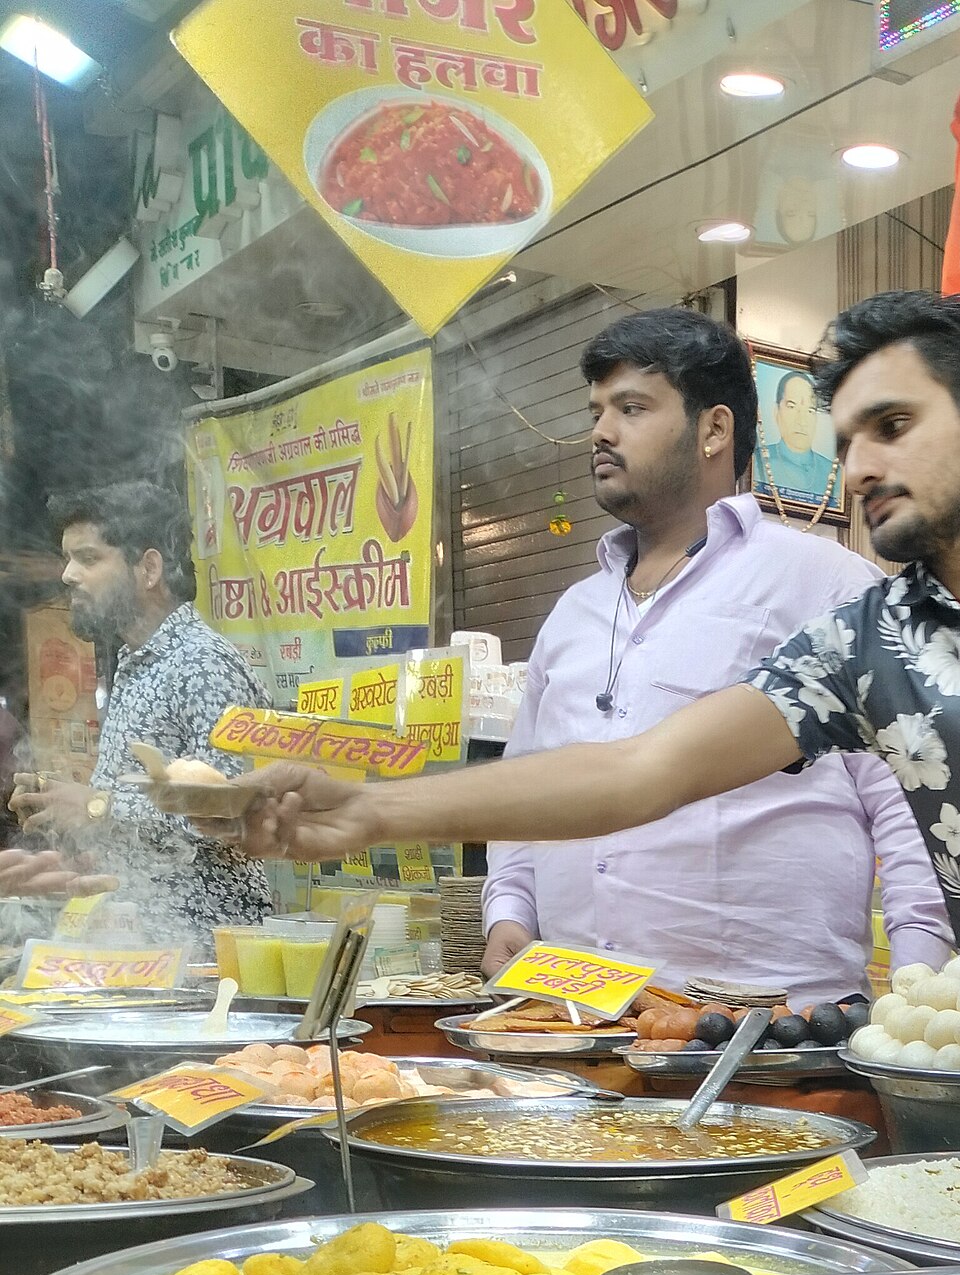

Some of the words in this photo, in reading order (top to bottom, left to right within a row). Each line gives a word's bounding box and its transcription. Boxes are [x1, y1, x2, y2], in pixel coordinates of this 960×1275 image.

[296, 18, 380, 74] का
[391, 37, 544, 99] हलवा
[313, 426, 327, 451] की
[300, 685, 339, 713] गाजर
[350, 672, 397, 711] अखरोट
